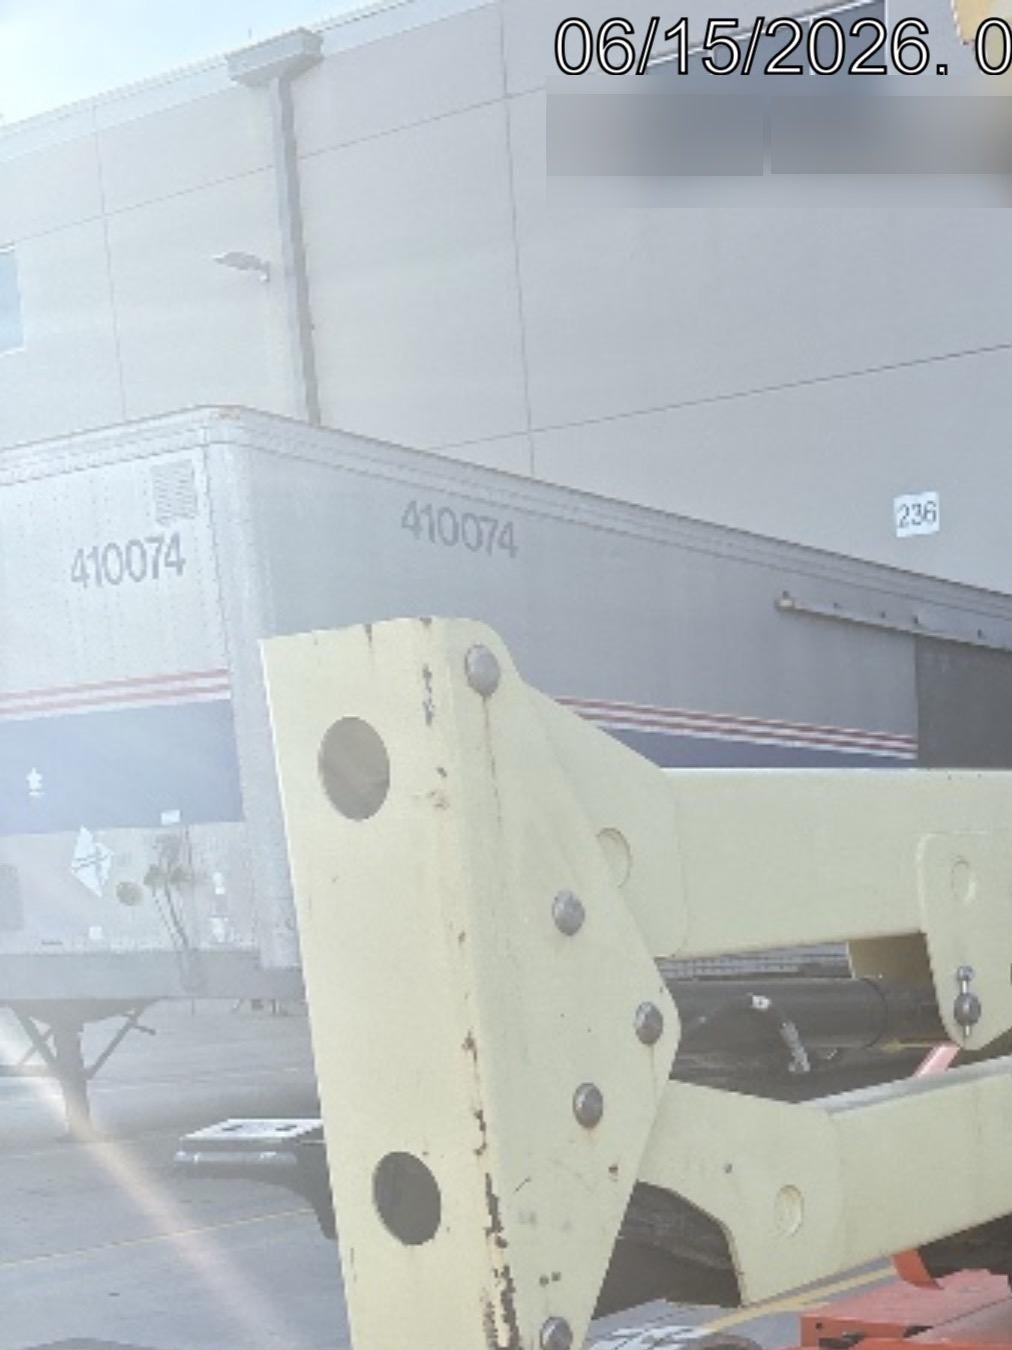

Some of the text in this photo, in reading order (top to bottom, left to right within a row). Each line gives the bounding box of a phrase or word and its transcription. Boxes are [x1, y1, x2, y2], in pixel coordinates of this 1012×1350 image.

[401, 500, 518, 558] 410074
[898, 500, 937, 529] 236
[70, 532, 186, 588] 410074
